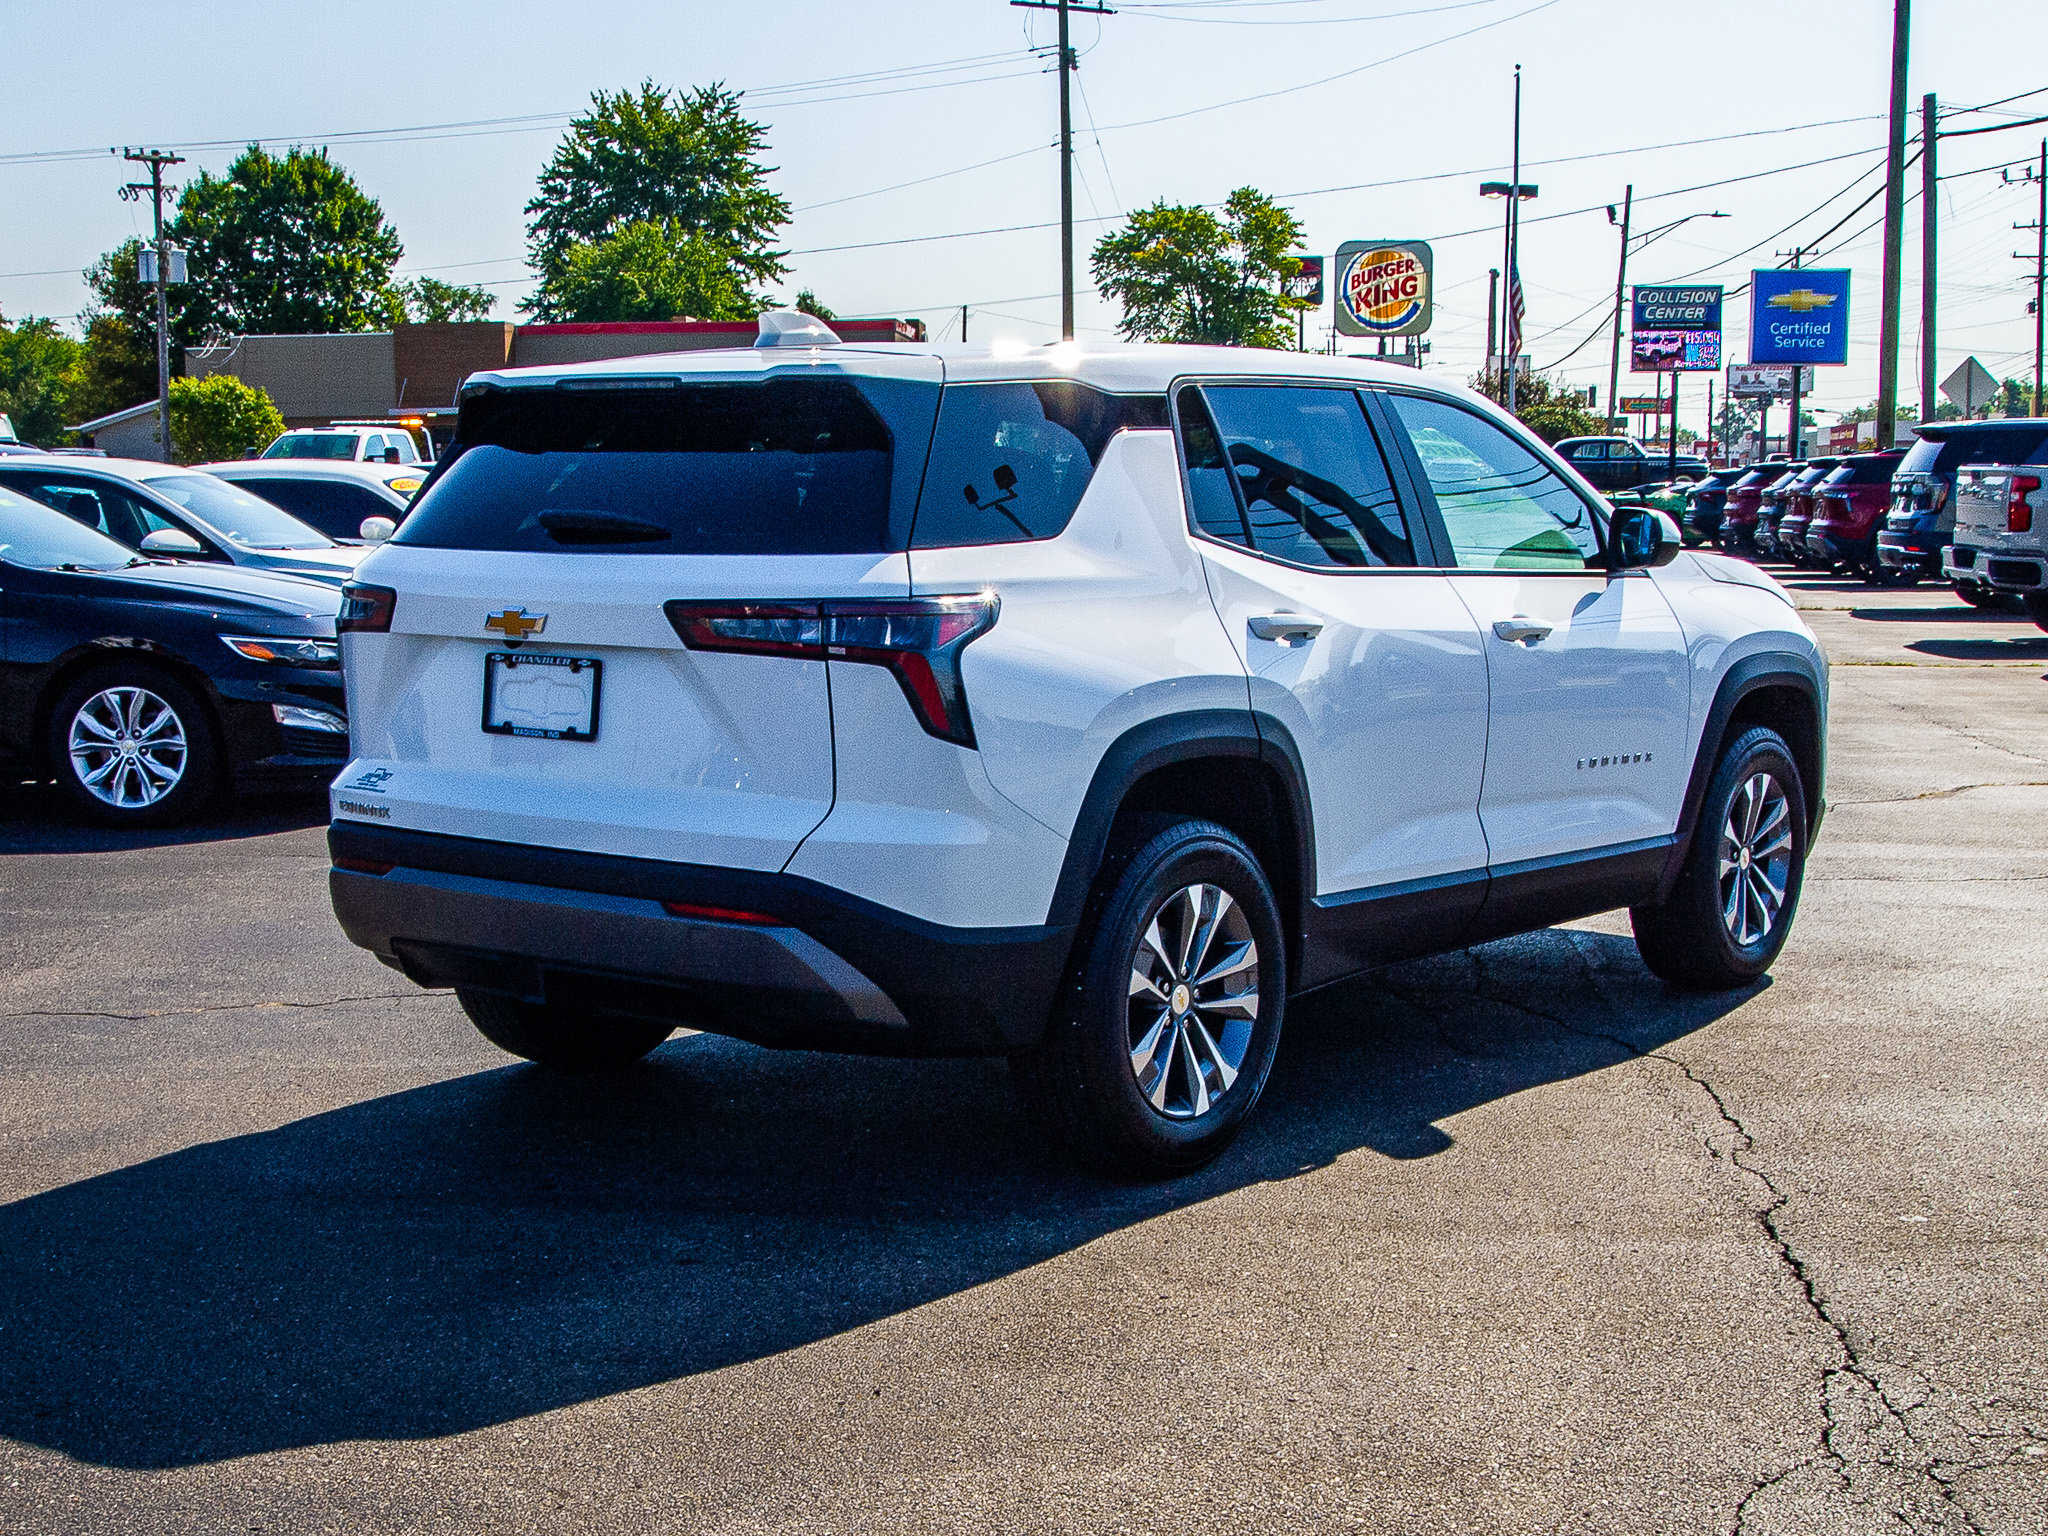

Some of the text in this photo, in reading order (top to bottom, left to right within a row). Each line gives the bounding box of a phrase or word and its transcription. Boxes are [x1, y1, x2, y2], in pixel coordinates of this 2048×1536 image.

[1351, 258, 1415, 290] BURGER
[1355, 275, 1418, 314] KING
[1638, 290, 1717, 304] COLLISION
[1645, 306, 1705, 319] CENTER
[1770, 322, 1831, 335] Certified
[1775, 336, 1825, 348] Service
[512, 655, 571, 666] CHANDLER
[1577, 752, 1653, 770] EQUINOX
